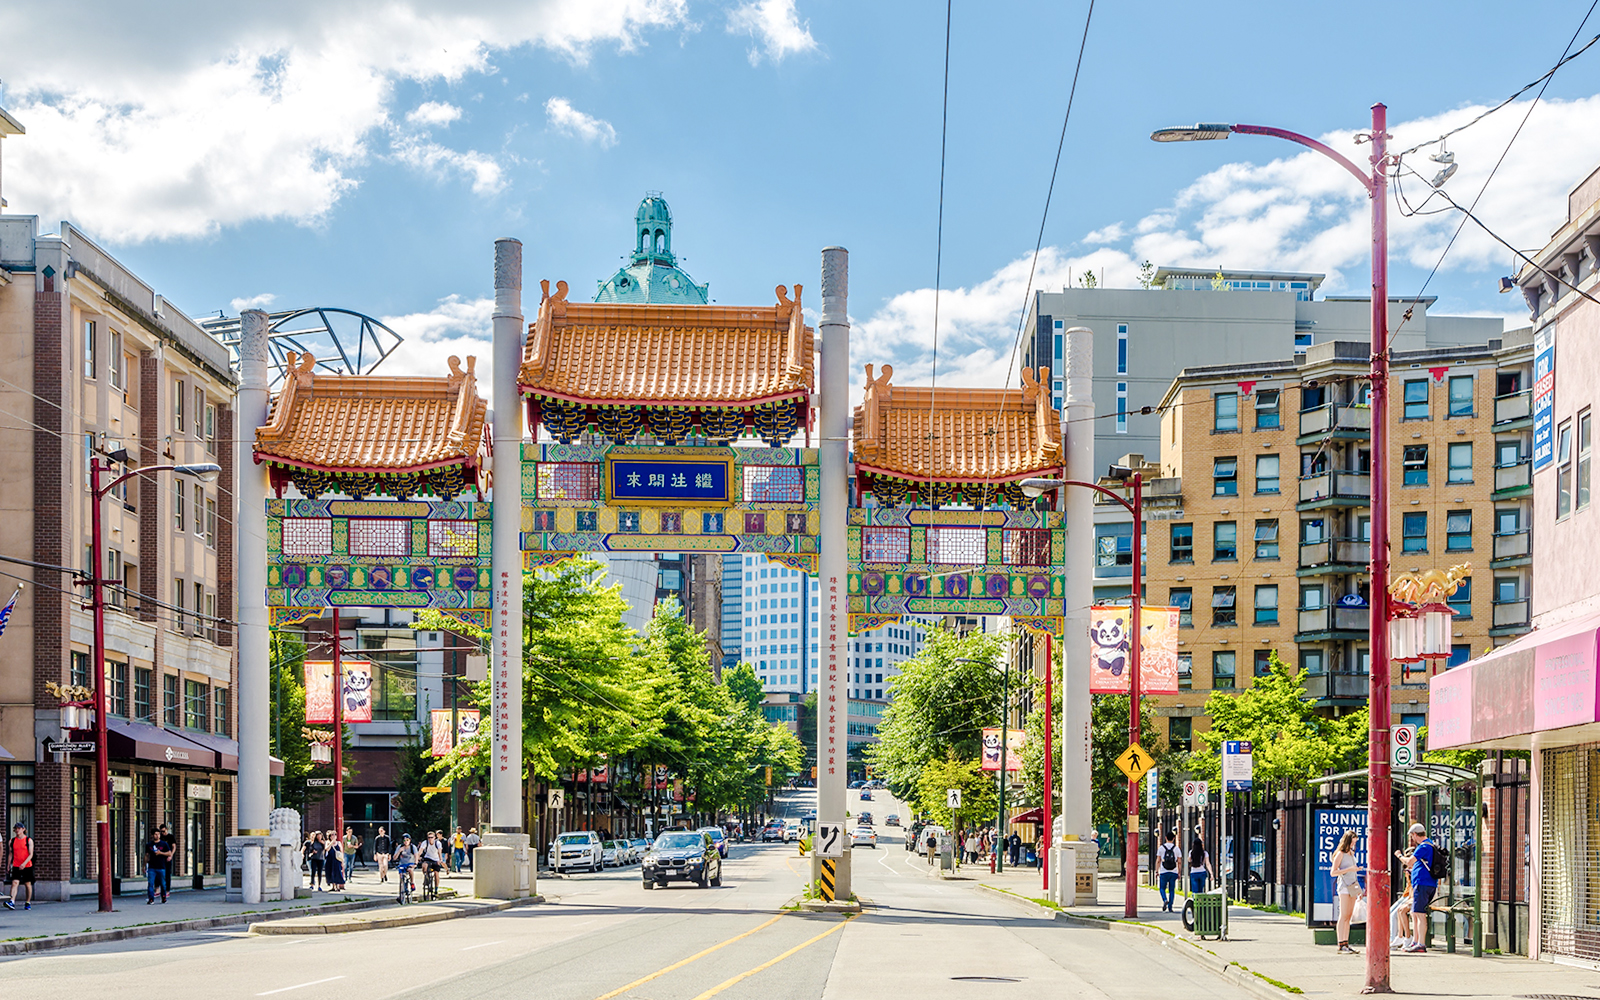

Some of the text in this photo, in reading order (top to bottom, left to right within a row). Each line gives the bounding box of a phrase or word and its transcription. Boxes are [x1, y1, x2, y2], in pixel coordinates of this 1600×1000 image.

[1545, 652, 1585, 671] PROFESSIONAL
[1540, 669, 1590, 691] SKIN CARE CENTRE
[1544, 696, 1565, 716] SINCE
[1228, 742, 1236, 752] T
[1320, 826, 1340, 836] FOR
[1320, 836, 1335, 850] IS
